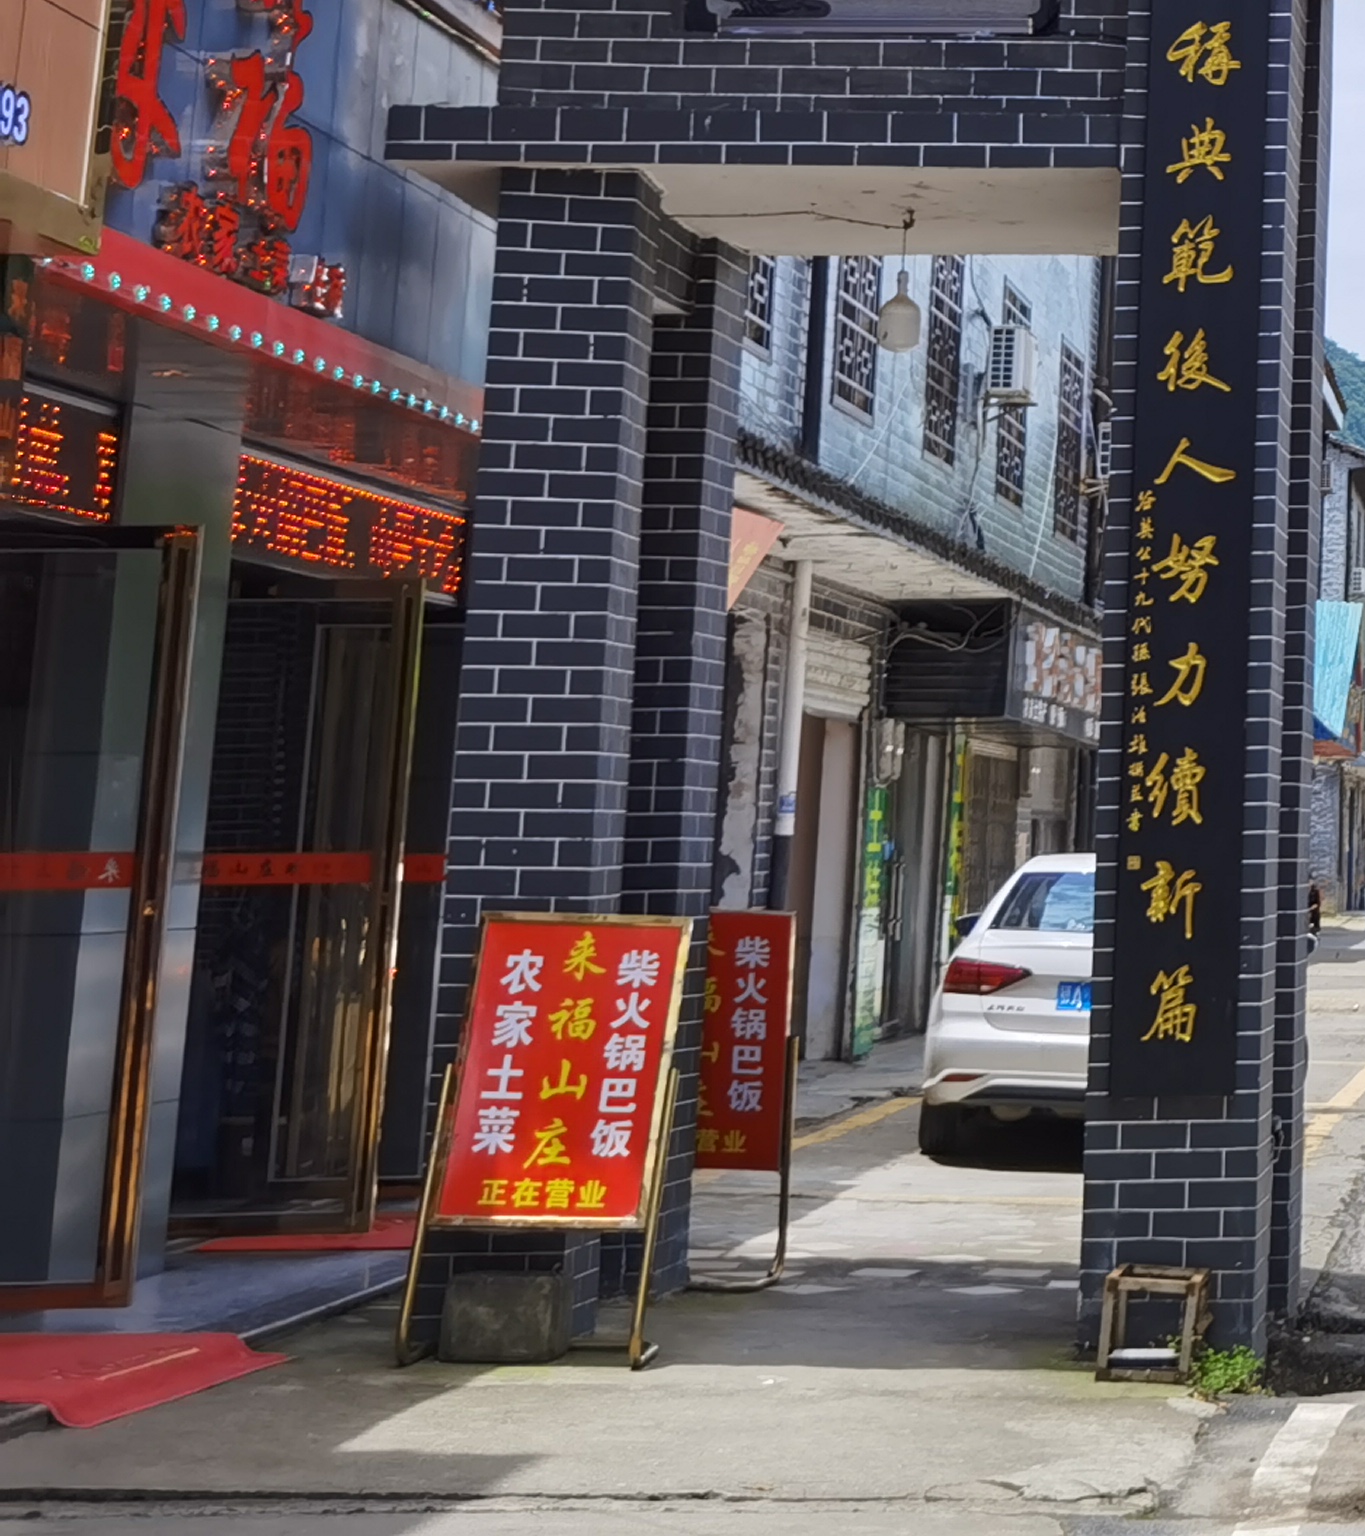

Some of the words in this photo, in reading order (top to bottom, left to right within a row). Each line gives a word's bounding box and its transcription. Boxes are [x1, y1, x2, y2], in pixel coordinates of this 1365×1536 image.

[471, 948, 545, 1157] 农家土菜
[522, 931, 606, 1171] 来福山庄
[590, 949, 661, 1158] 柴火锅巴饭
[727, 935, 771, 1113] 柴火锅巴饭
[477, 1177, 607, 1209] 正在营业
